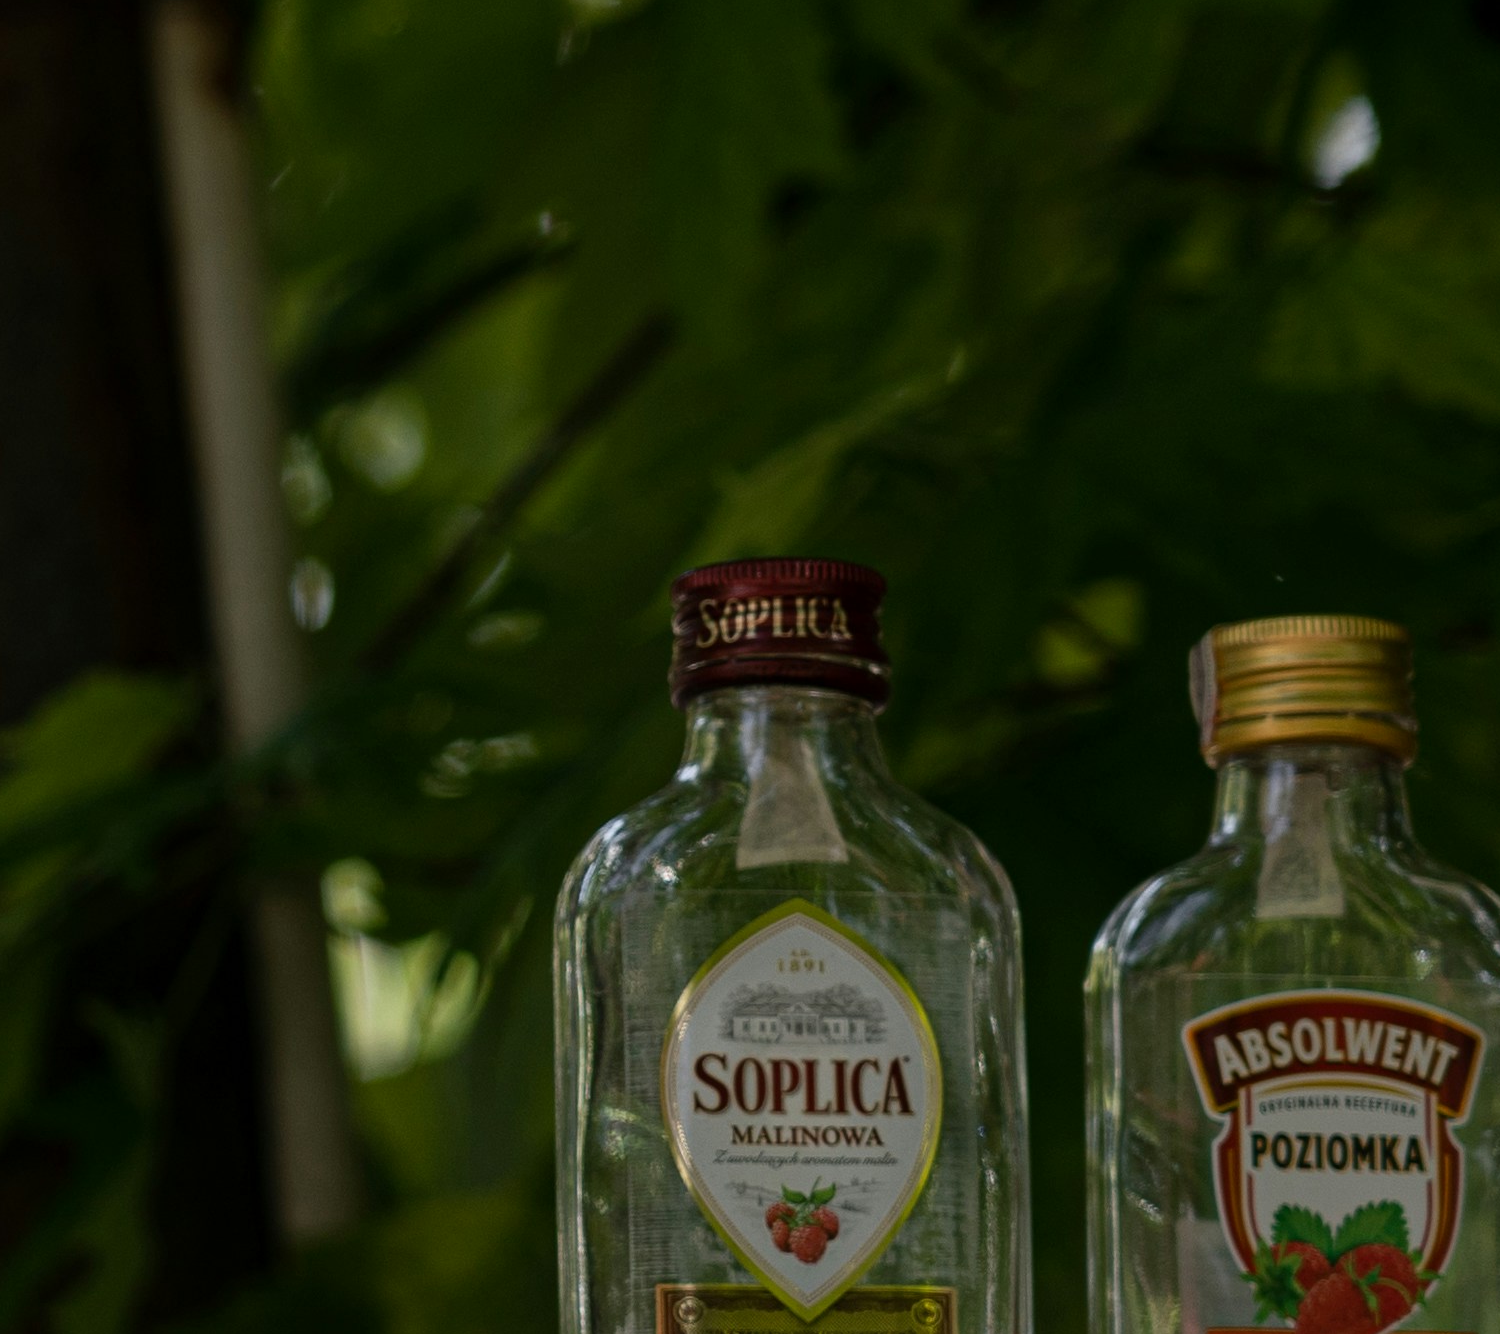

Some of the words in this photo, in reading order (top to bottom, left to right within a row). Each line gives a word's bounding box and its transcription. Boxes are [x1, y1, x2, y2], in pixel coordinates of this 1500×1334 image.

[695, 594, 853, 649] SOPLICA
[1212, 1016, 1460, 1086] ABSOLWENT
[693, 1052, 914, 1117] SOPLICA
[731, 1124, 884, 1147] MALINOWA
[1251, 1132, 1427, 1173] POZIOMKA
